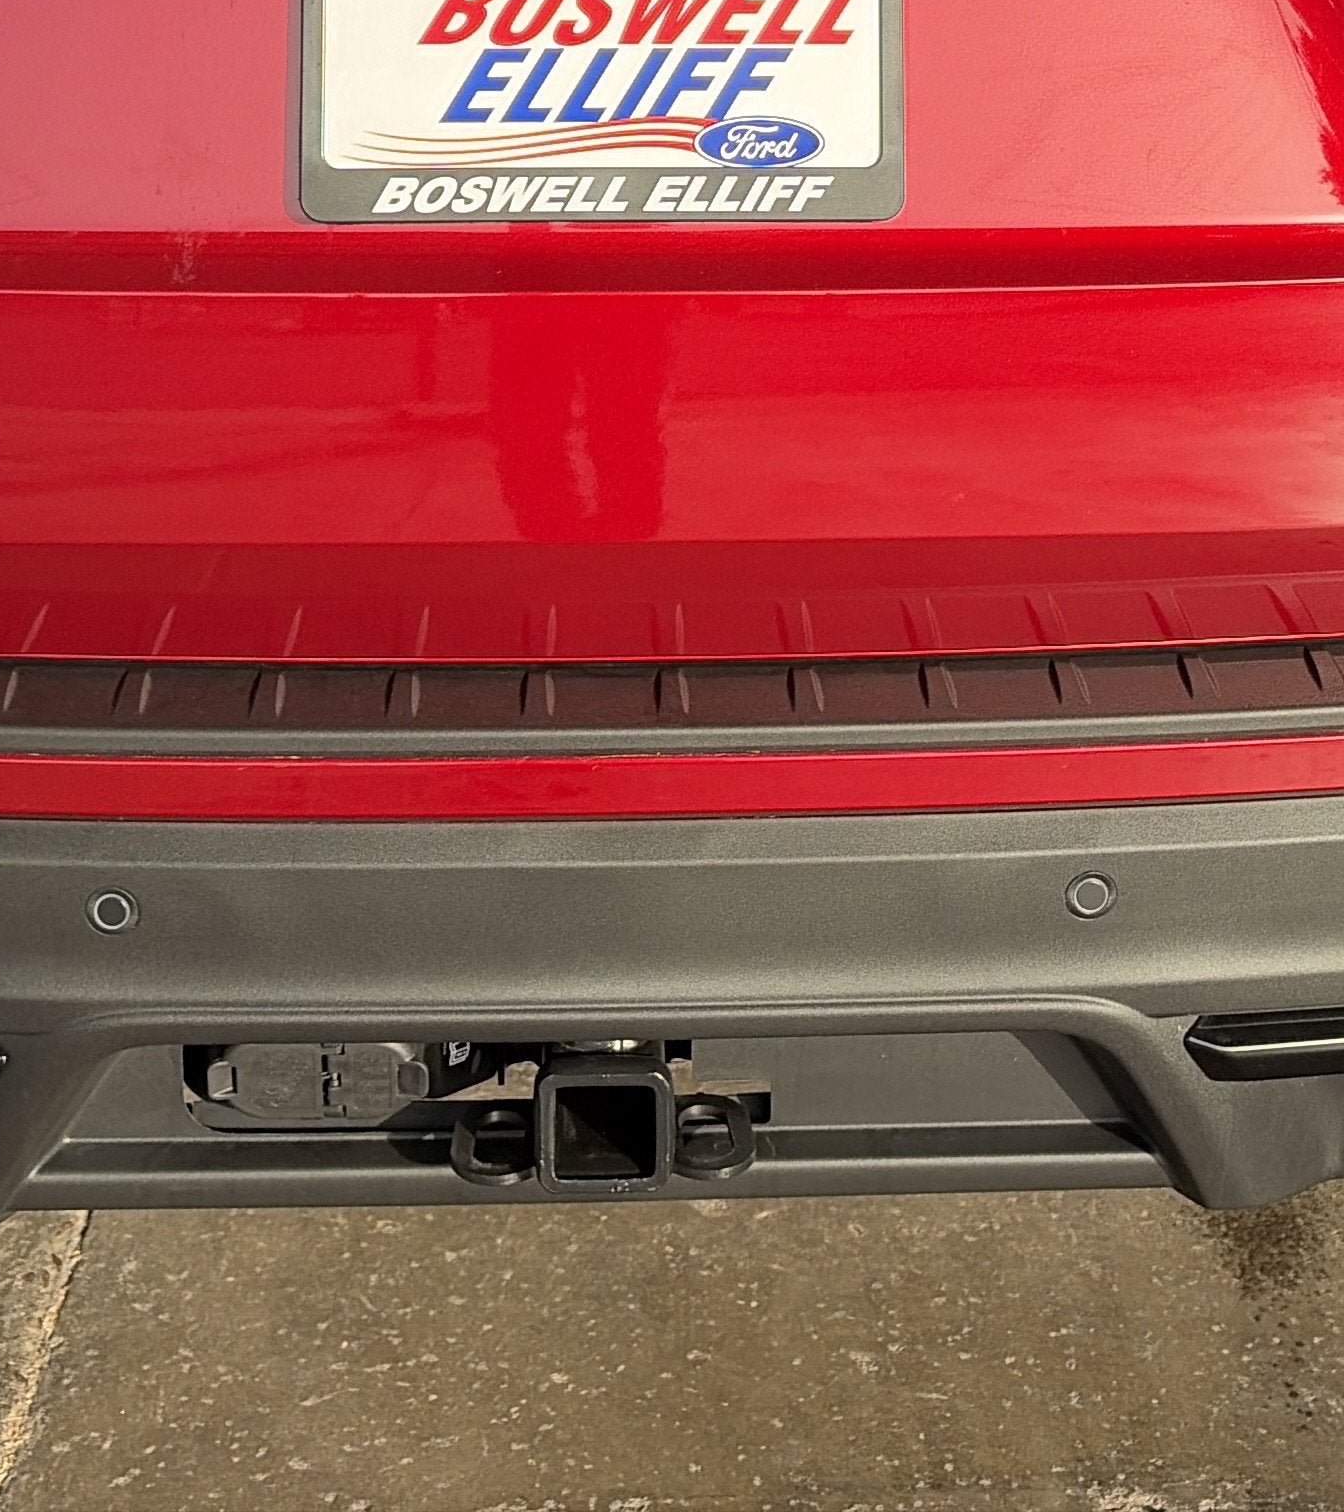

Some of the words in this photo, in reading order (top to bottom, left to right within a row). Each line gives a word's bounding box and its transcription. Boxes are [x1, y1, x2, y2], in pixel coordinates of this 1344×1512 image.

[438, 47, 793, 125] ELLIFF
[720, 124, 799, 160] Ford
[371, 175, 629, 215] BOSWELL
[642, 175, 835, 213] ELLIFF
